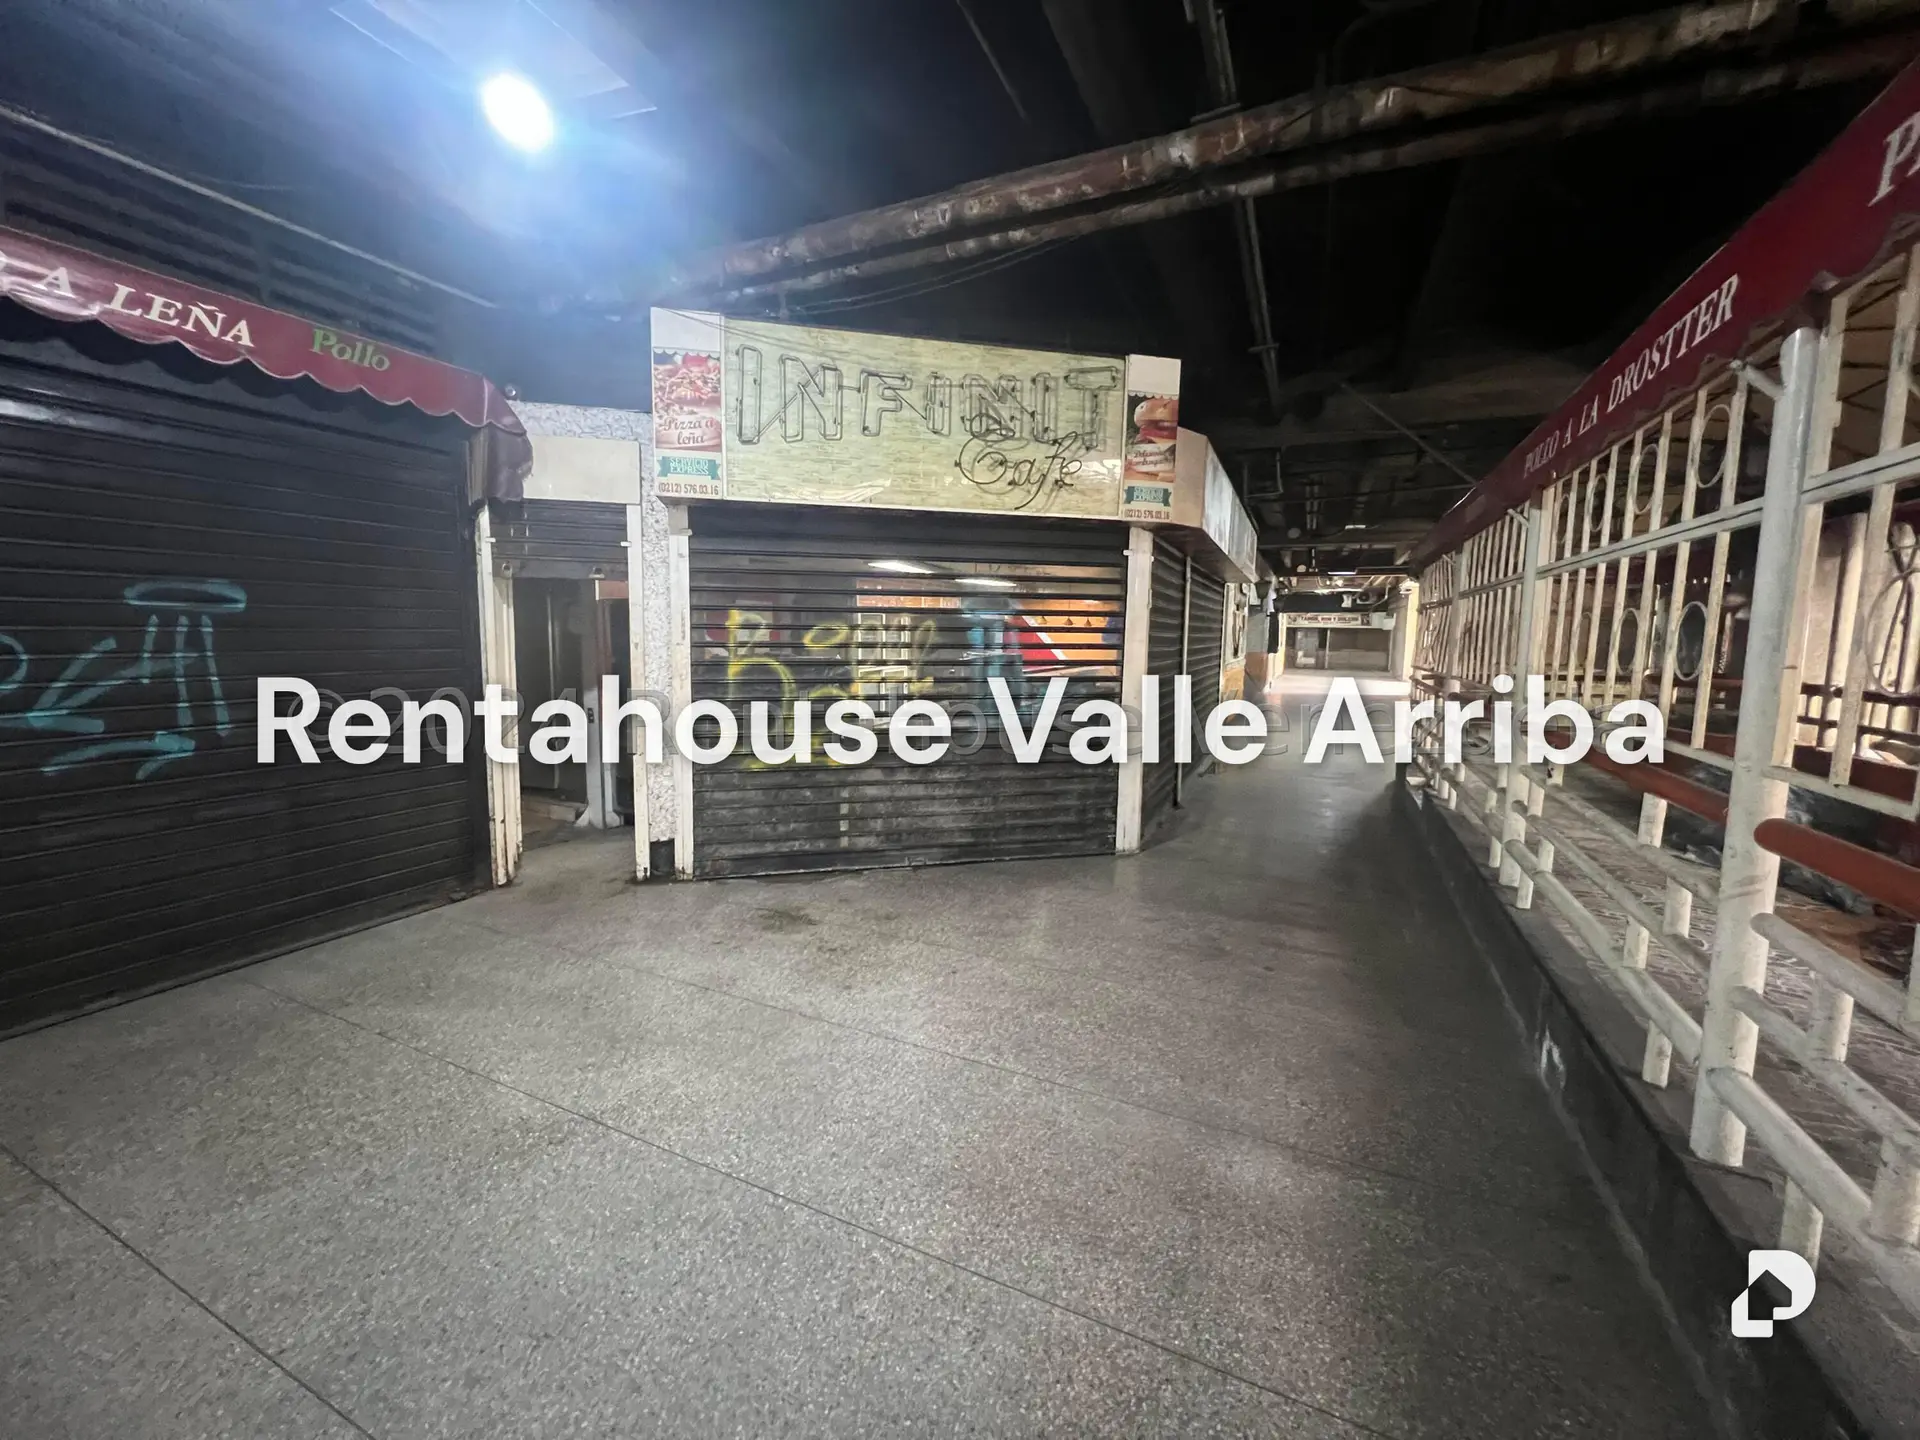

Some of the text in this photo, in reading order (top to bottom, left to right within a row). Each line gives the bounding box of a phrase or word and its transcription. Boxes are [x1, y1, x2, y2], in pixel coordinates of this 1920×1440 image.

[32, 266, 255, 348] A LEÑA
[310, 328, 391, 372] Pollo
[1562, 418, 1573, 449] A
[1577, 394, 1599, 437] LA
[1606, 273, 1739, 413] DROSTTER
[659, 417, 702, 431] Pizza
[669, 457, 709, 467] SERVICIO
[658, 482, 682, 493] (0212)
